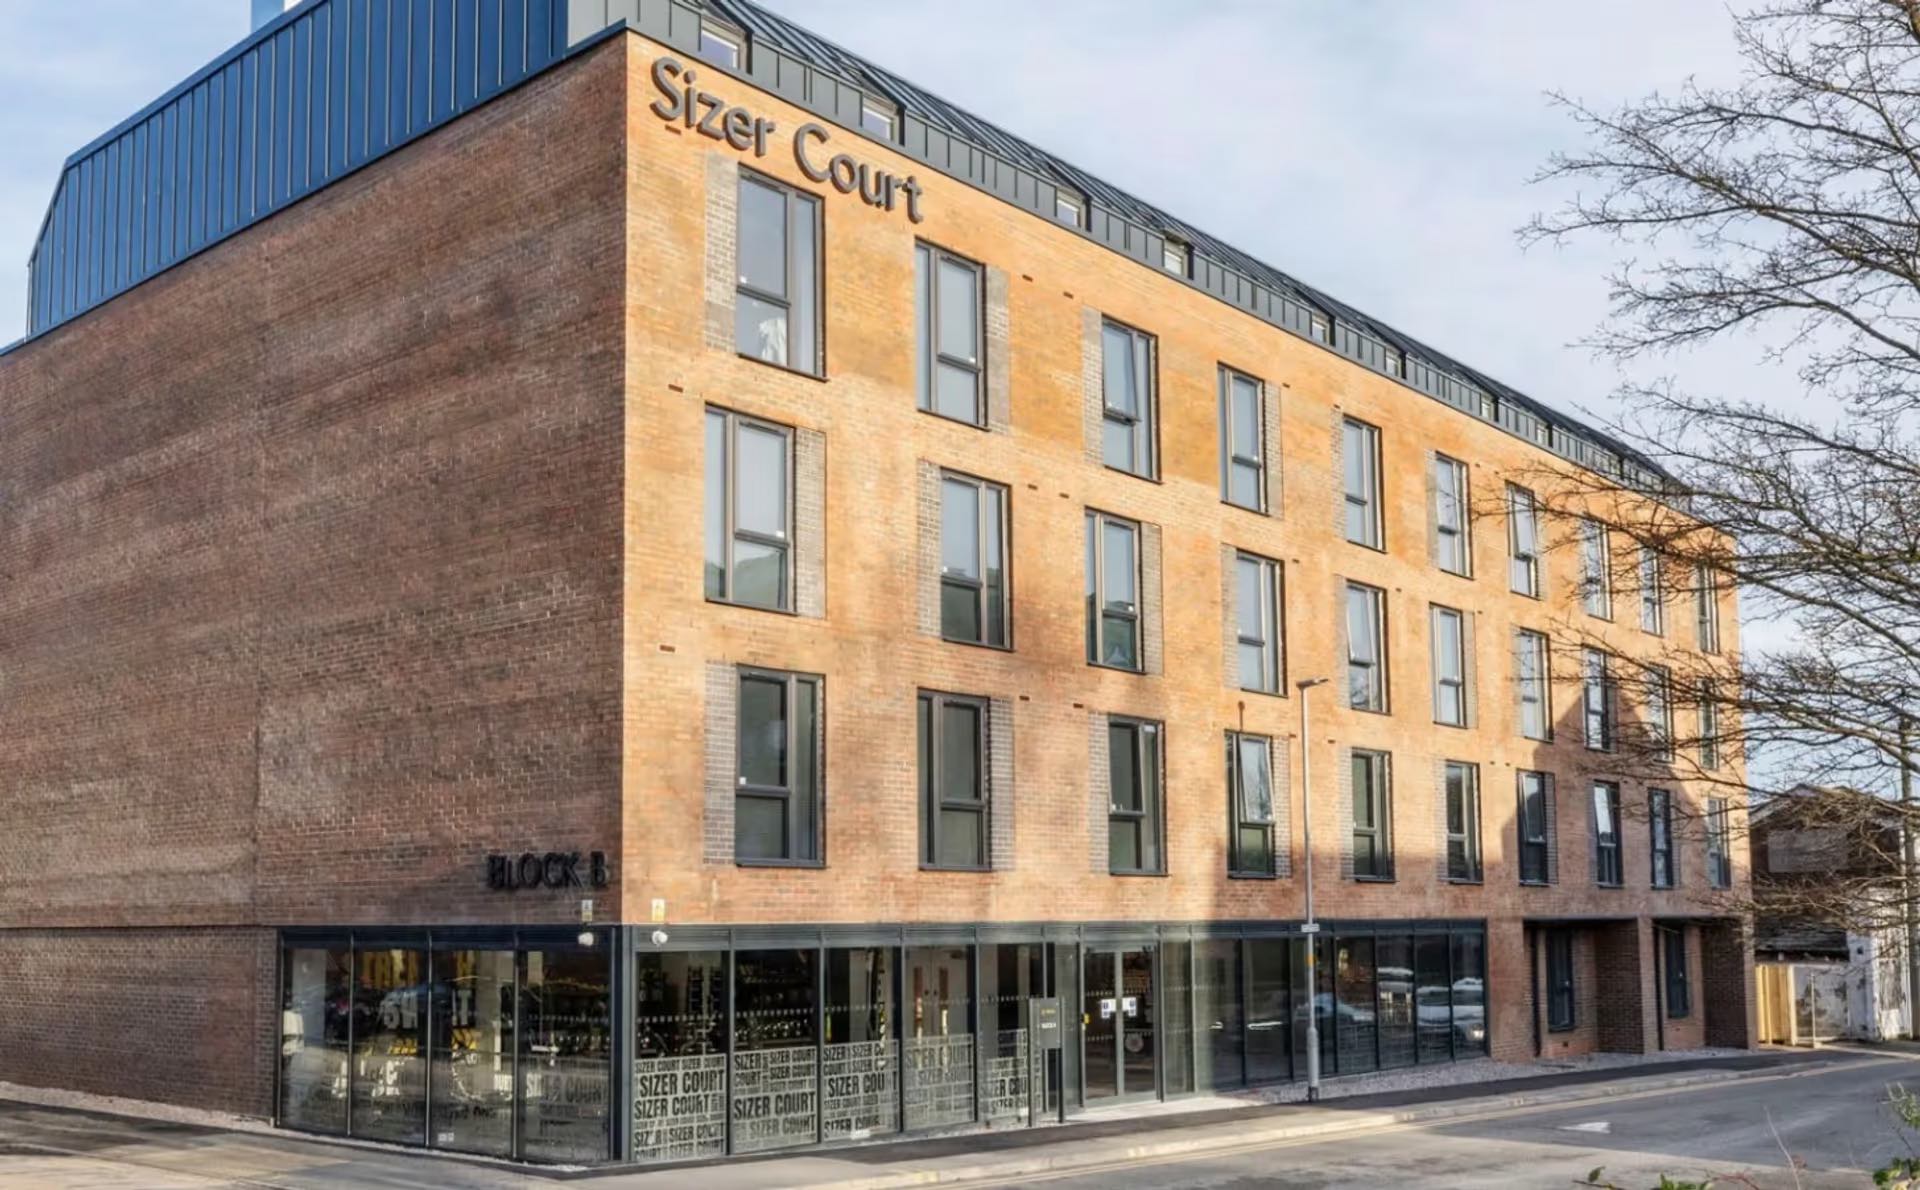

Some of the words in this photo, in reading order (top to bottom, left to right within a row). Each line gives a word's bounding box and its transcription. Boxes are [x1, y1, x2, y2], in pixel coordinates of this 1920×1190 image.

[650, 57, 775, 158] Sizer
[794, 122, 923, 224] Court
[487, 851, 582, 889] BLOCK
[590, 851, 610, 889] B
[639, 1073, 678, 1098] SIZER
[682, 1069, 725, 1095] COURT
[827, 1076, 860, 1098] SIZER
[862, 1071, 898, 1094] COUT
[634, 1097, 668, 1121] SIZER
[672, 1094, 710, 1116] COURT
[734, 1096, 771, 1121] SIZER
[775, 1091, 816, 1117] COURT
